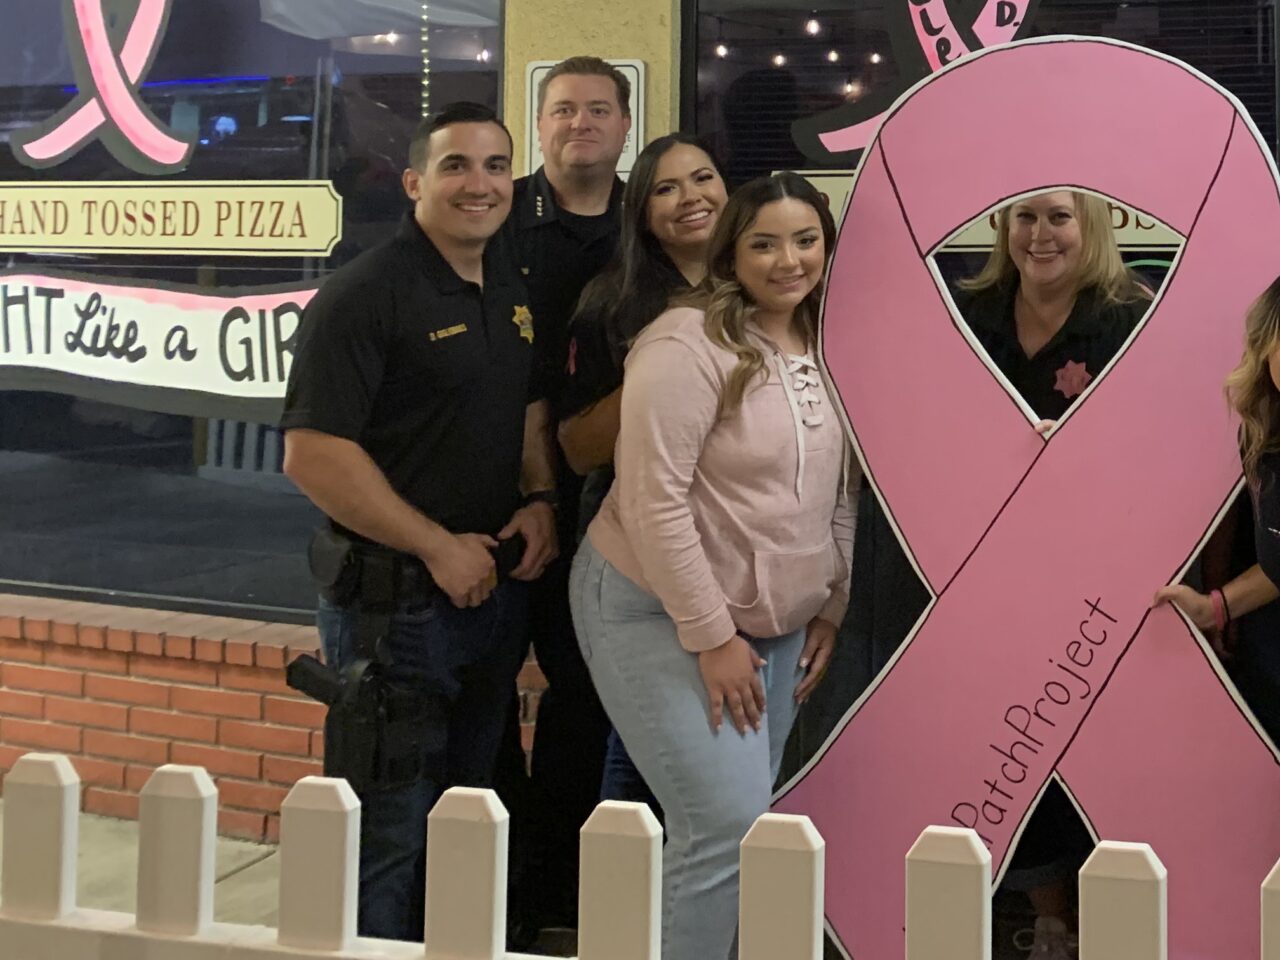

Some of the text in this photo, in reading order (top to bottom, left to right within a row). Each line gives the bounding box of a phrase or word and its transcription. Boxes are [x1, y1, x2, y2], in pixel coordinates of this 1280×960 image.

[81, 200, 201, 237] TOSSED
[214, 200, 308, 238] PIZZA
[64, 291, 147, 363] Like
[163, 324, 198, 362] a
